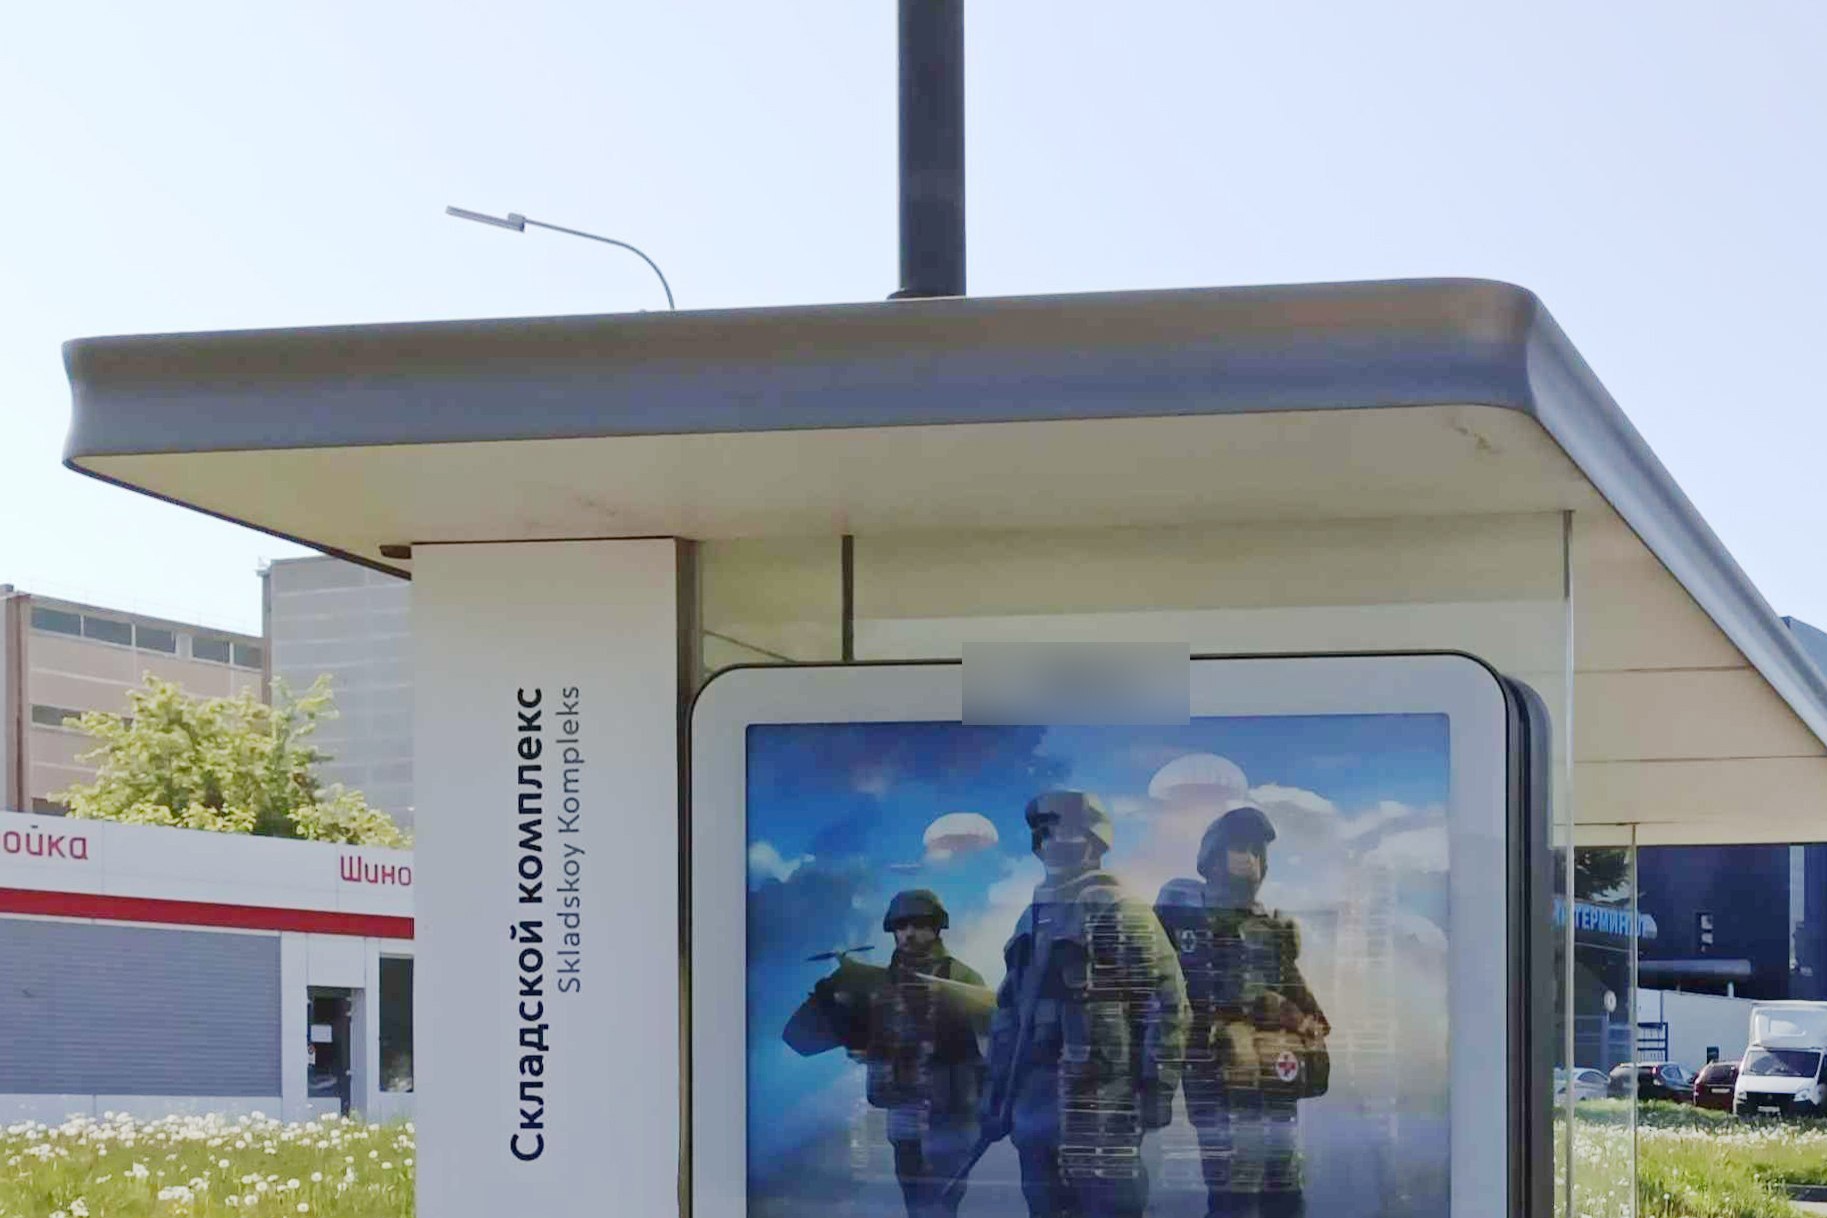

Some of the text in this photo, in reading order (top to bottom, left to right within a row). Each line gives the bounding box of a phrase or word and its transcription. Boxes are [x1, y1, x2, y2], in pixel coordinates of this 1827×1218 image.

[341, 856, 411, 886] Шино
[510, 688, 549, 1161] Складской комплекс
[556, 687, 585, 992] Skladskoy Kompleks
